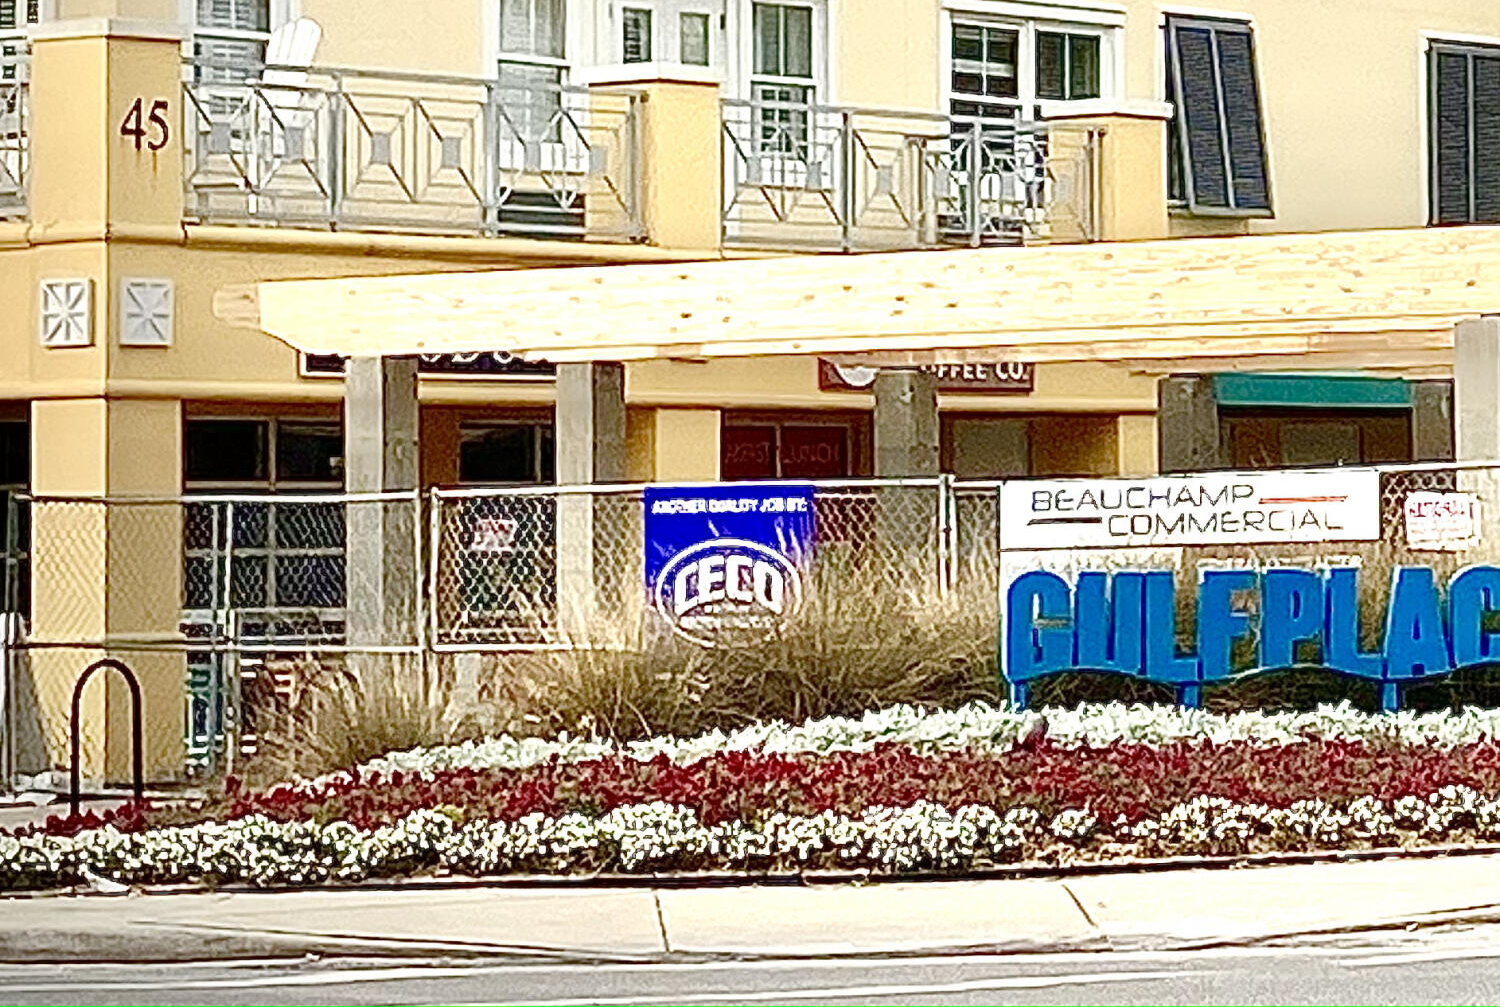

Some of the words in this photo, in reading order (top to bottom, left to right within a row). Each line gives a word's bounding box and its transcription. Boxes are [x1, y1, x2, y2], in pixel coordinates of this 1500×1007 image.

[121, 98, 168, 151] 45
[920, 364, 987, 379] FFEE
[1031, 484, 1254, 512] BEAUCHAMP
[1107, 509, 1344, 536] COMMERCIAL
[673, 554, 785, 616] CECO
